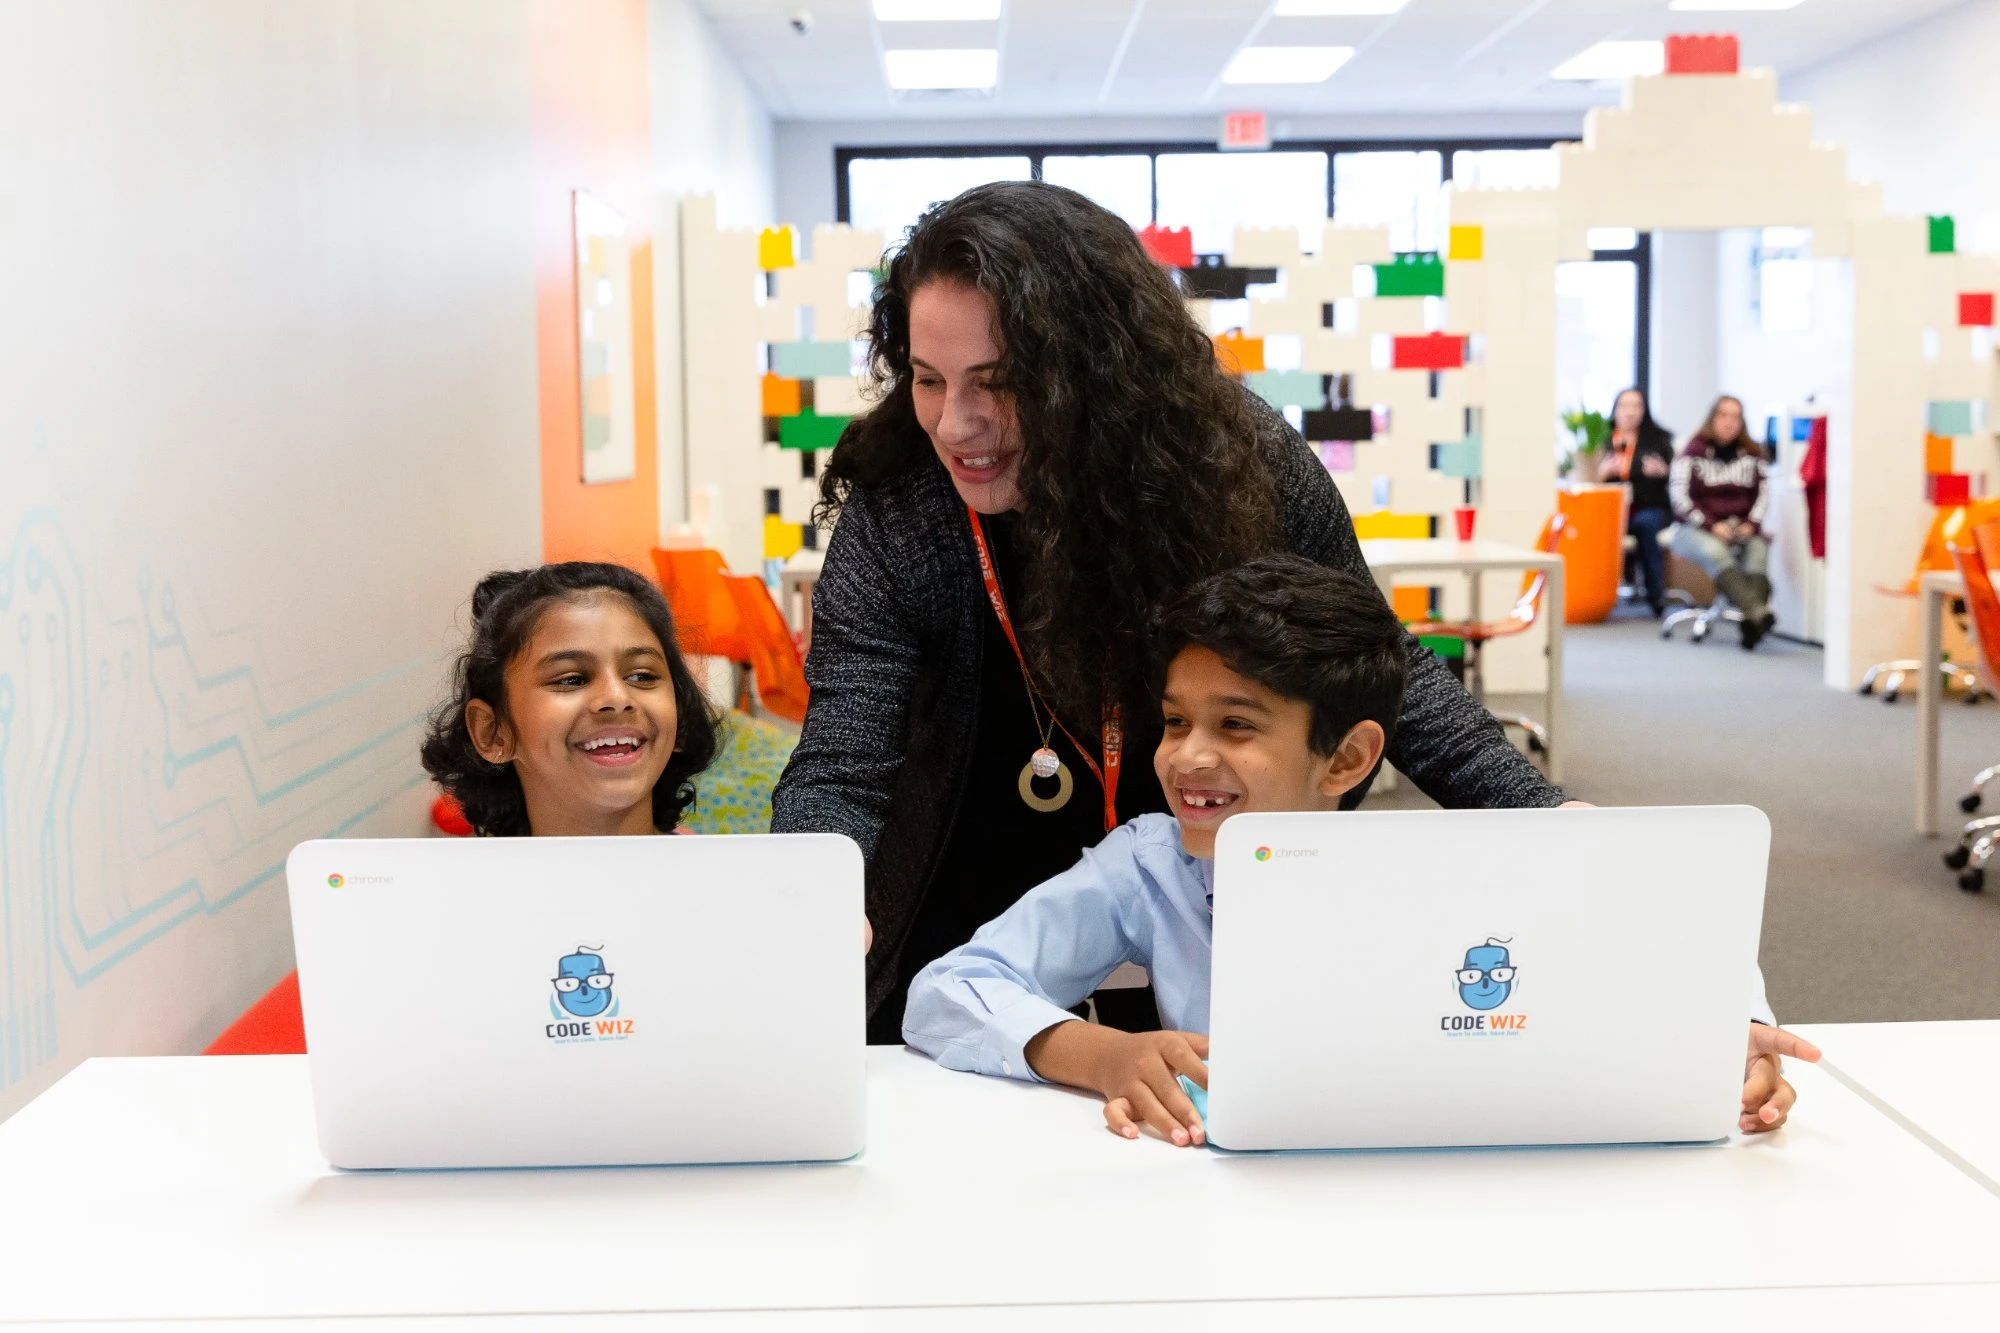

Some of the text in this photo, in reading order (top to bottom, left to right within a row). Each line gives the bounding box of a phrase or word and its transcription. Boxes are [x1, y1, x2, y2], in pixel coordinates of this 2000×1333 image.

[989, 589, 1007, 622] WIZ
[1274, 847, 1319, 857] chrome
[348, 873, 394, 885] chrome
[546, 1020, 634, 1038] CODE WIZ
[1441, 1015, 1527, 1031] CODE WIZ
